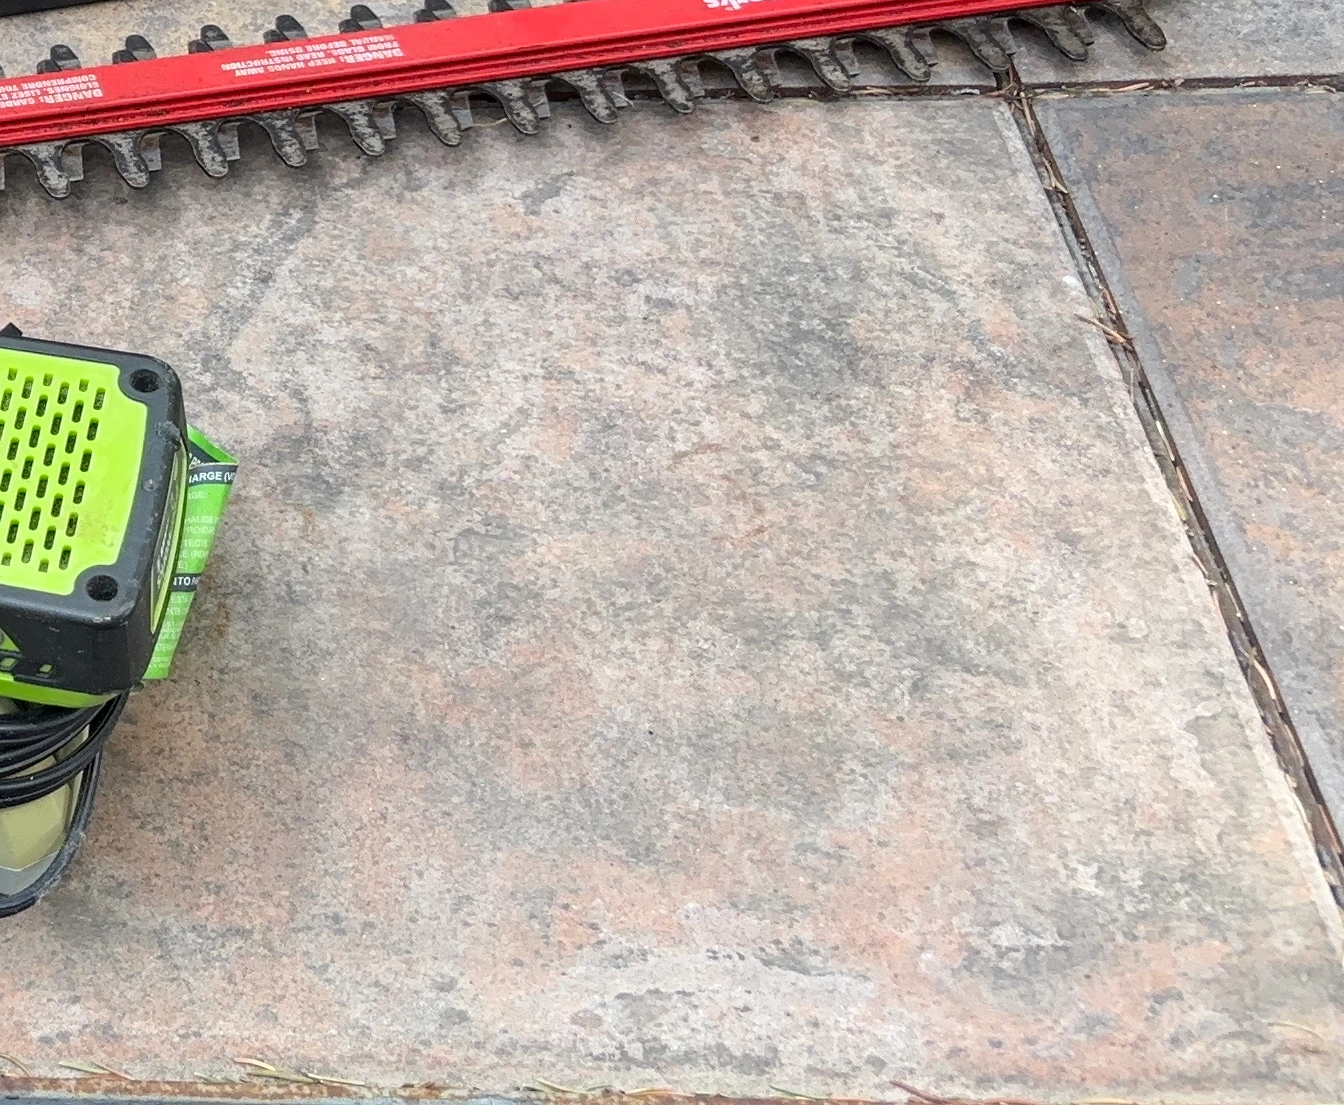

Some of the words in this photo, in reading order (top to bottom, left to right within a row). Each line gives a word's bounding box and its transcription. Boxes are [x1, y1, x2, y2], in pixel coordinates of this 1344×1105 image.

[349, 35, 394, 45] MANUAL
[305, 41, 346, 51] BEFORE
[367, 41, 399, 50] FROM
[296, 51, 324, 60] READ
[340, 48, 403, 62] DANGER:
[221, 56, 293, 70] INSTRUCTION
[267, 62, 305, 71] HANDS
[308, 57, 336, 66] KEEP
[235, 67, 264, 76] AWAY
[21, 74, 95, 90] COMPRENDRE
[11, 89, 39, 99] LISEZ
[39, 89, 103, 103] DANGER:
